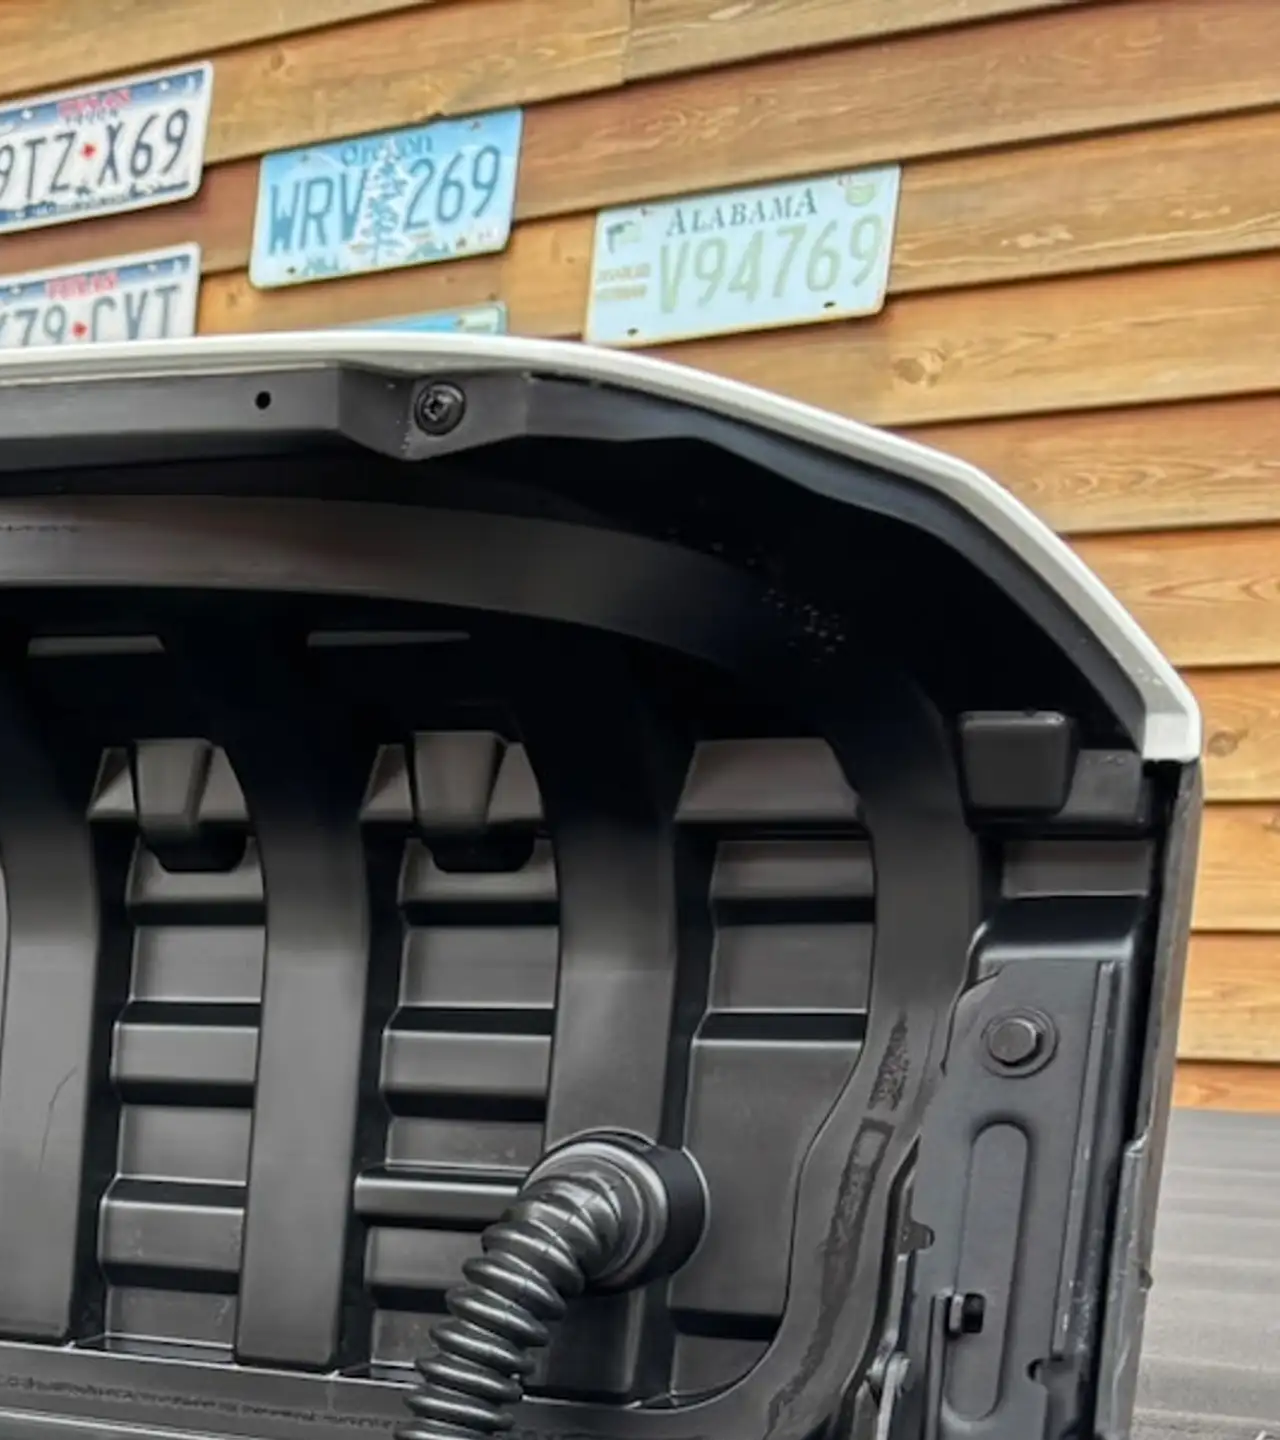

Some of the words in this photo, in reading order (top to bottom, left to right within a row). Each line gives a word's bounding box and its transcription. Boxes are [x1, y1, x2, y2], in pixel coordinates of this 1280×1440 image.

[268, 168, 368, 255] WRV
[403, 145, 501, 233] 269
[666, 187, 819, 236] ALABAMA
[659, 213, 883, 314] V94769
